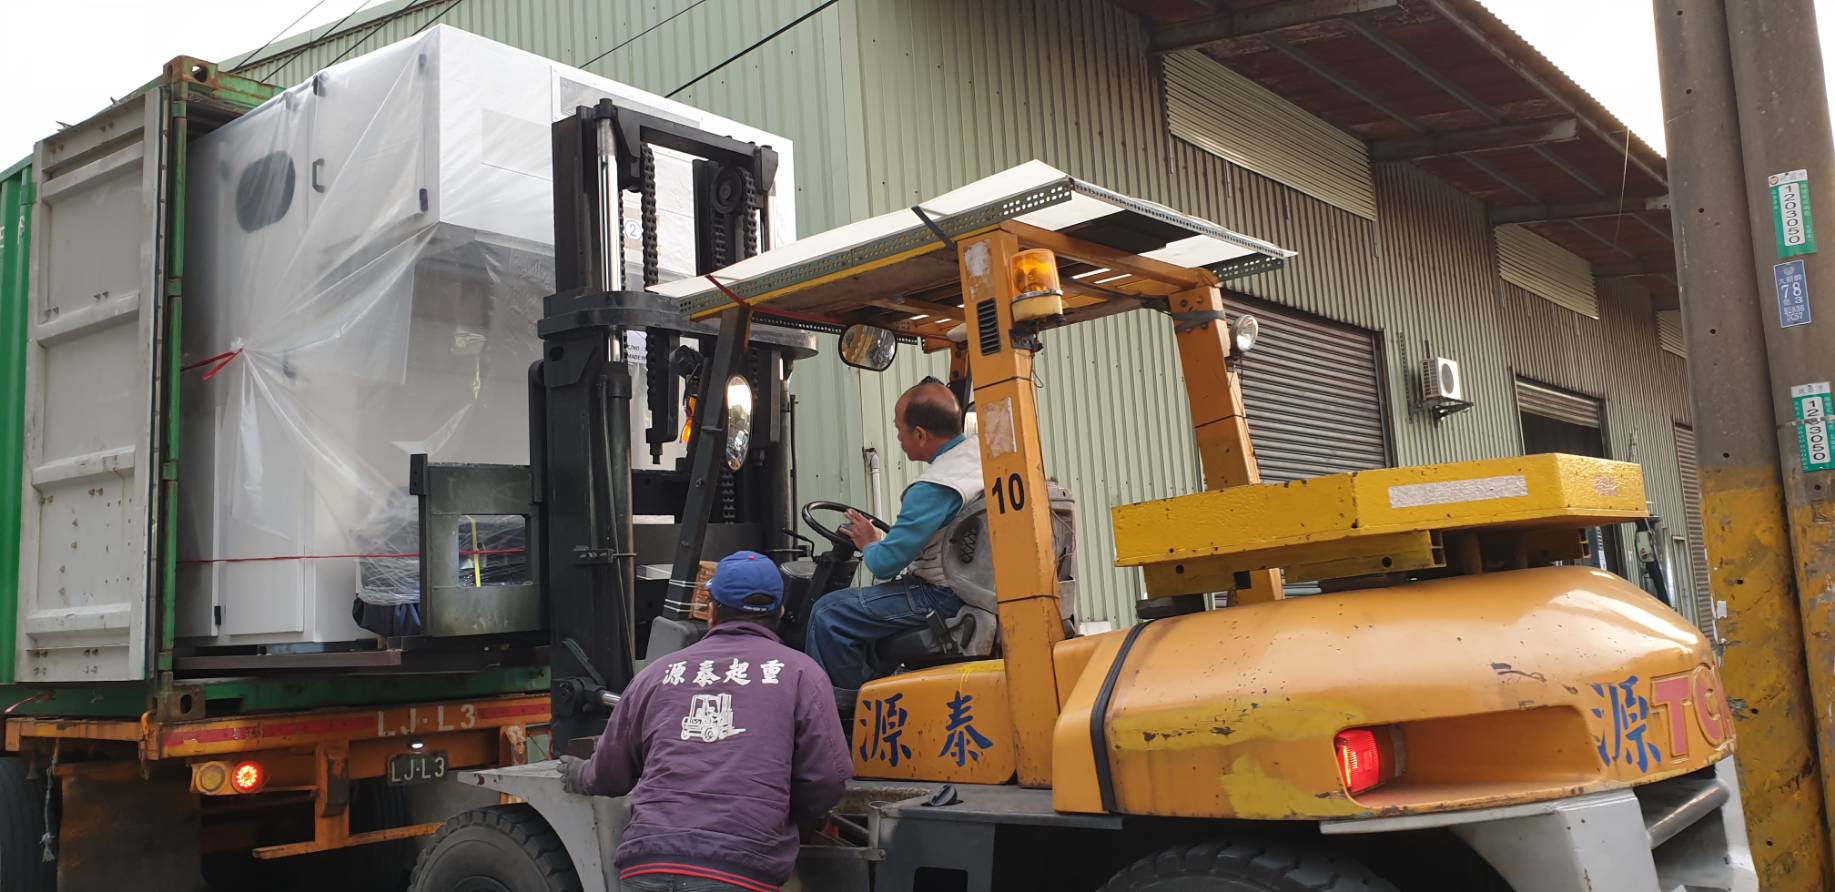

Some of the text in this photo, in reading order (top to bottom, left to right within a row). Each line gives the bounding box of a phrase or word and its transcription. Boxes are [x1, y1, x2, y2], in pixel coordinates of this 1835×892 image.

[1783, 185, 1801, 244] 1203050
[991, 472, 1025, 514] 10
[661, 657, 785, 688] 源泰起重
[859, 689, 993, 768] 源泰
[1591, 675, 1662, 774] 源
